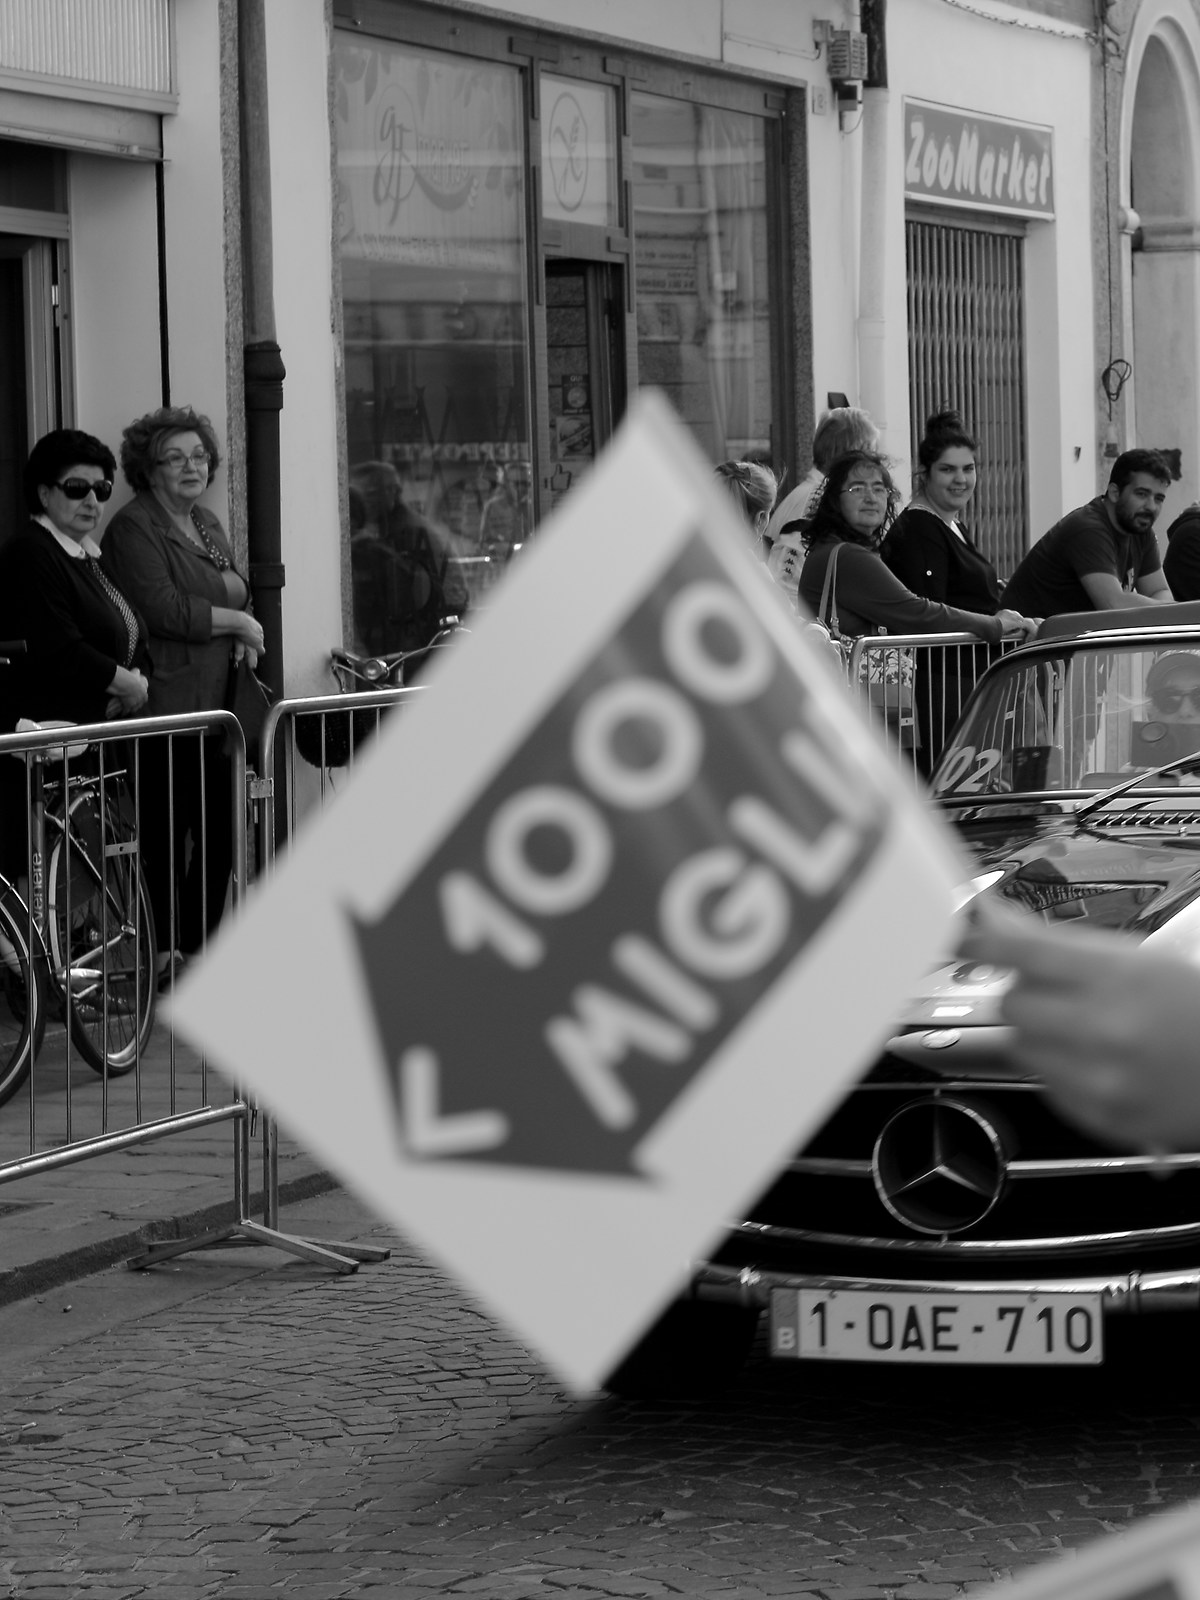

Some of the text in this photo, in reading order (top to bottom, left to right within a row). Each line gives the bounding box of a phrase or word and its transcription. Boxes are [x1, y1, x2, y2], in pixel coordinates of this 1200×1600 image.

[905, 114, 1050, 206] ZooMarket
[436, 579, 778, 971] 1000
[32, 852, 43, 921] venere
[777, 1301, 1093, 1354] B 1-OAE-710
